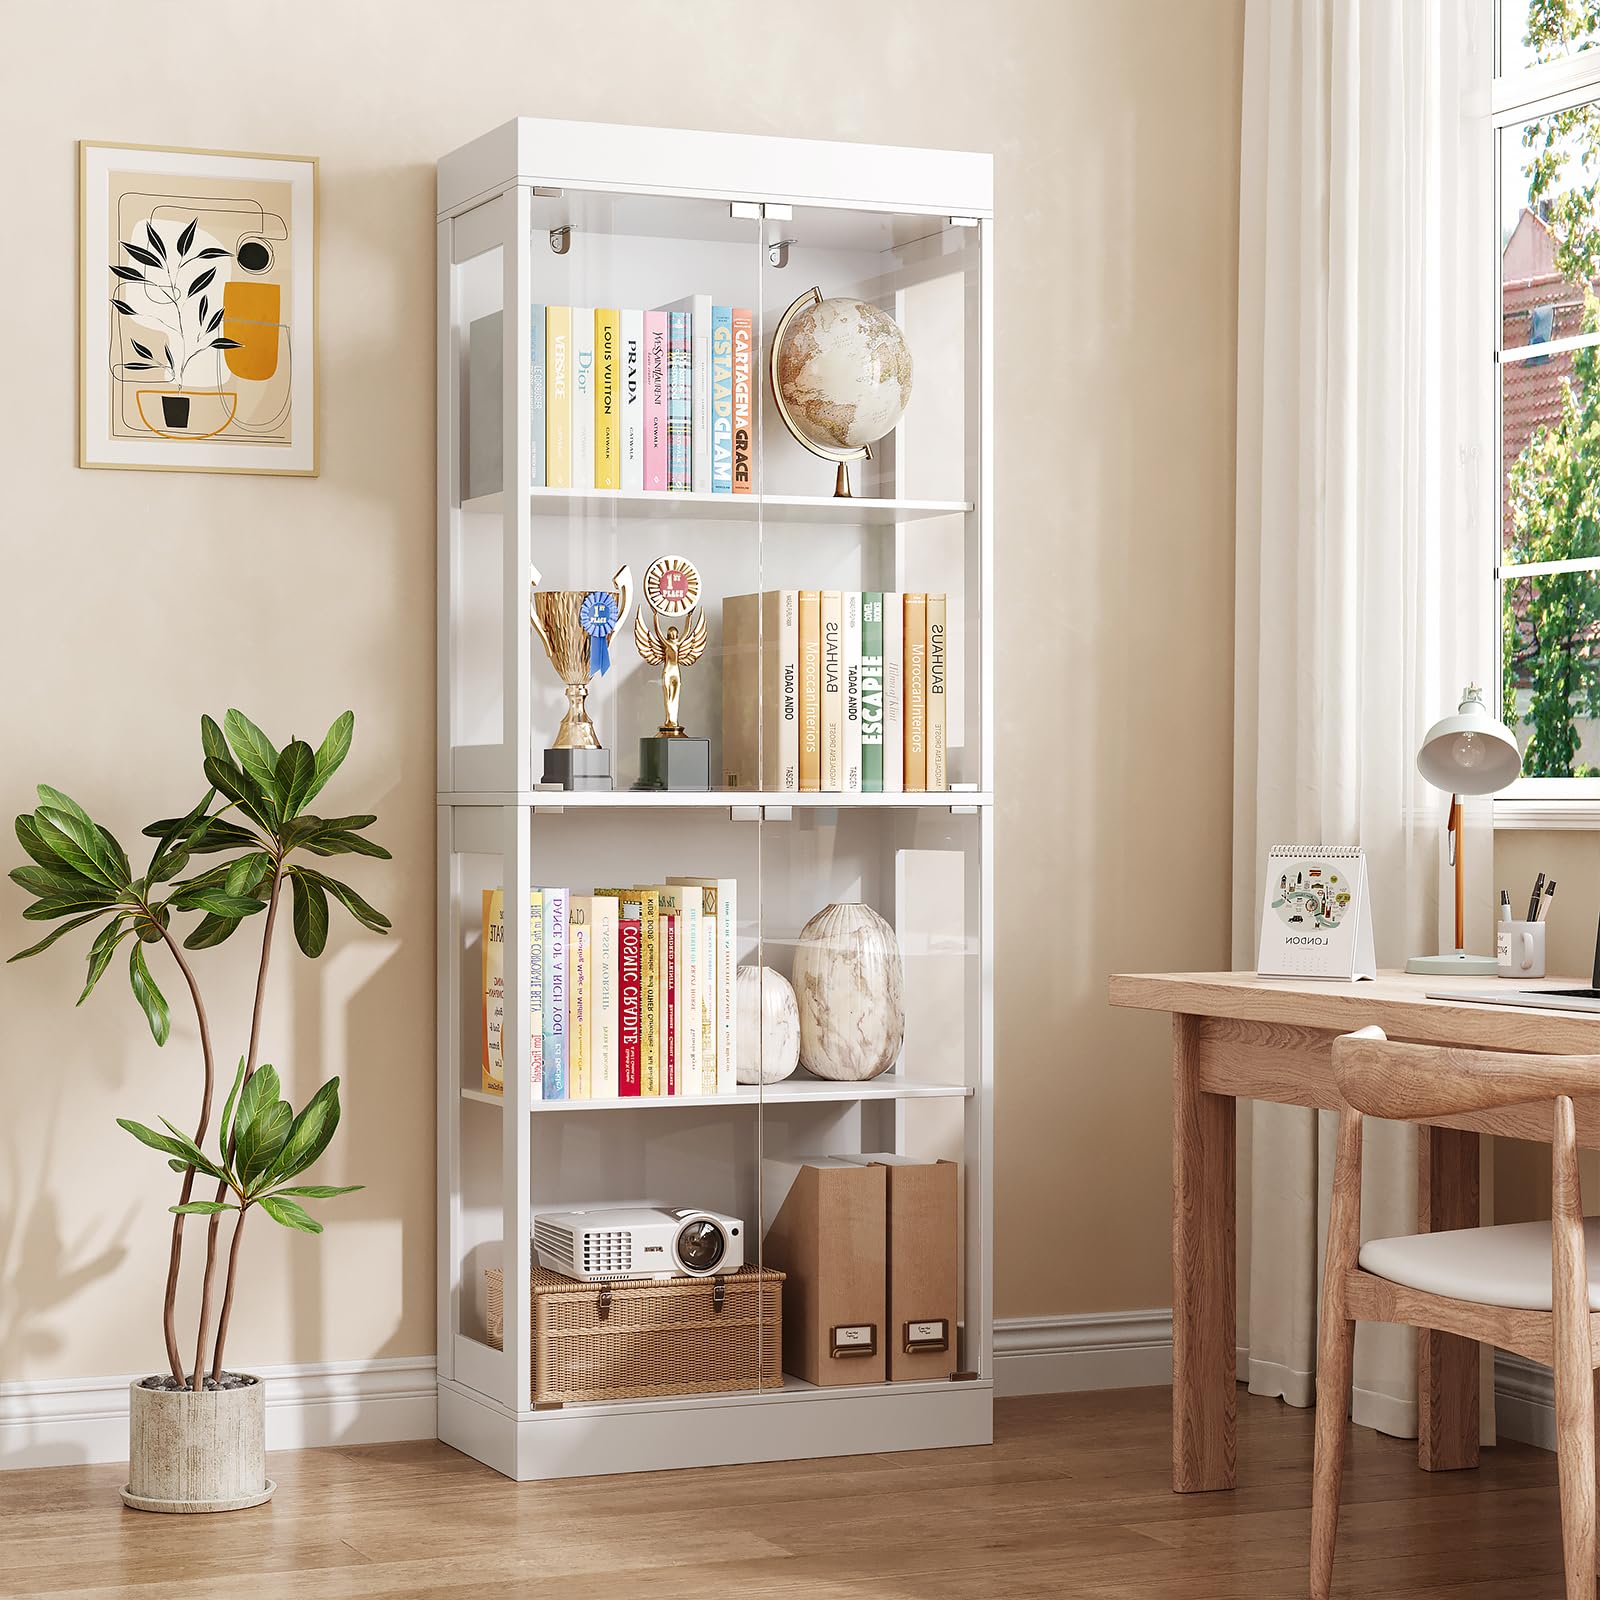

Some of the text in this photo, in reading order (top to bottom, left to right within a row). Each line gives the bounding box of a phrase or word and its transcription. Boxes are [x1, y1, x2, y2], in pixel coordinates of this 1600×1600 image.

[555, 335, 565, 399] VERSACE
[579, 352, 592, 393] Dior
[628, 340, 637, 405] PRADA
[714, 327, 731, 417] GSTAAD
[735, 331, 748, 429] CARTAGENA
[714, 417, 731, 481] GLAM
[735, 429, 748, 482] GRACE
[663, 589, 684, 598] PLACE
[784, 664, 794, 720] TADAO ANDO
[806, 642, 818, 752] Moroccan Interiors
[848, 665, 857, 720] TADAO ANDO
[862, 656, 882, 744] ESCAPEE
[912, 644, 924, 753] Moroccan Interiors
